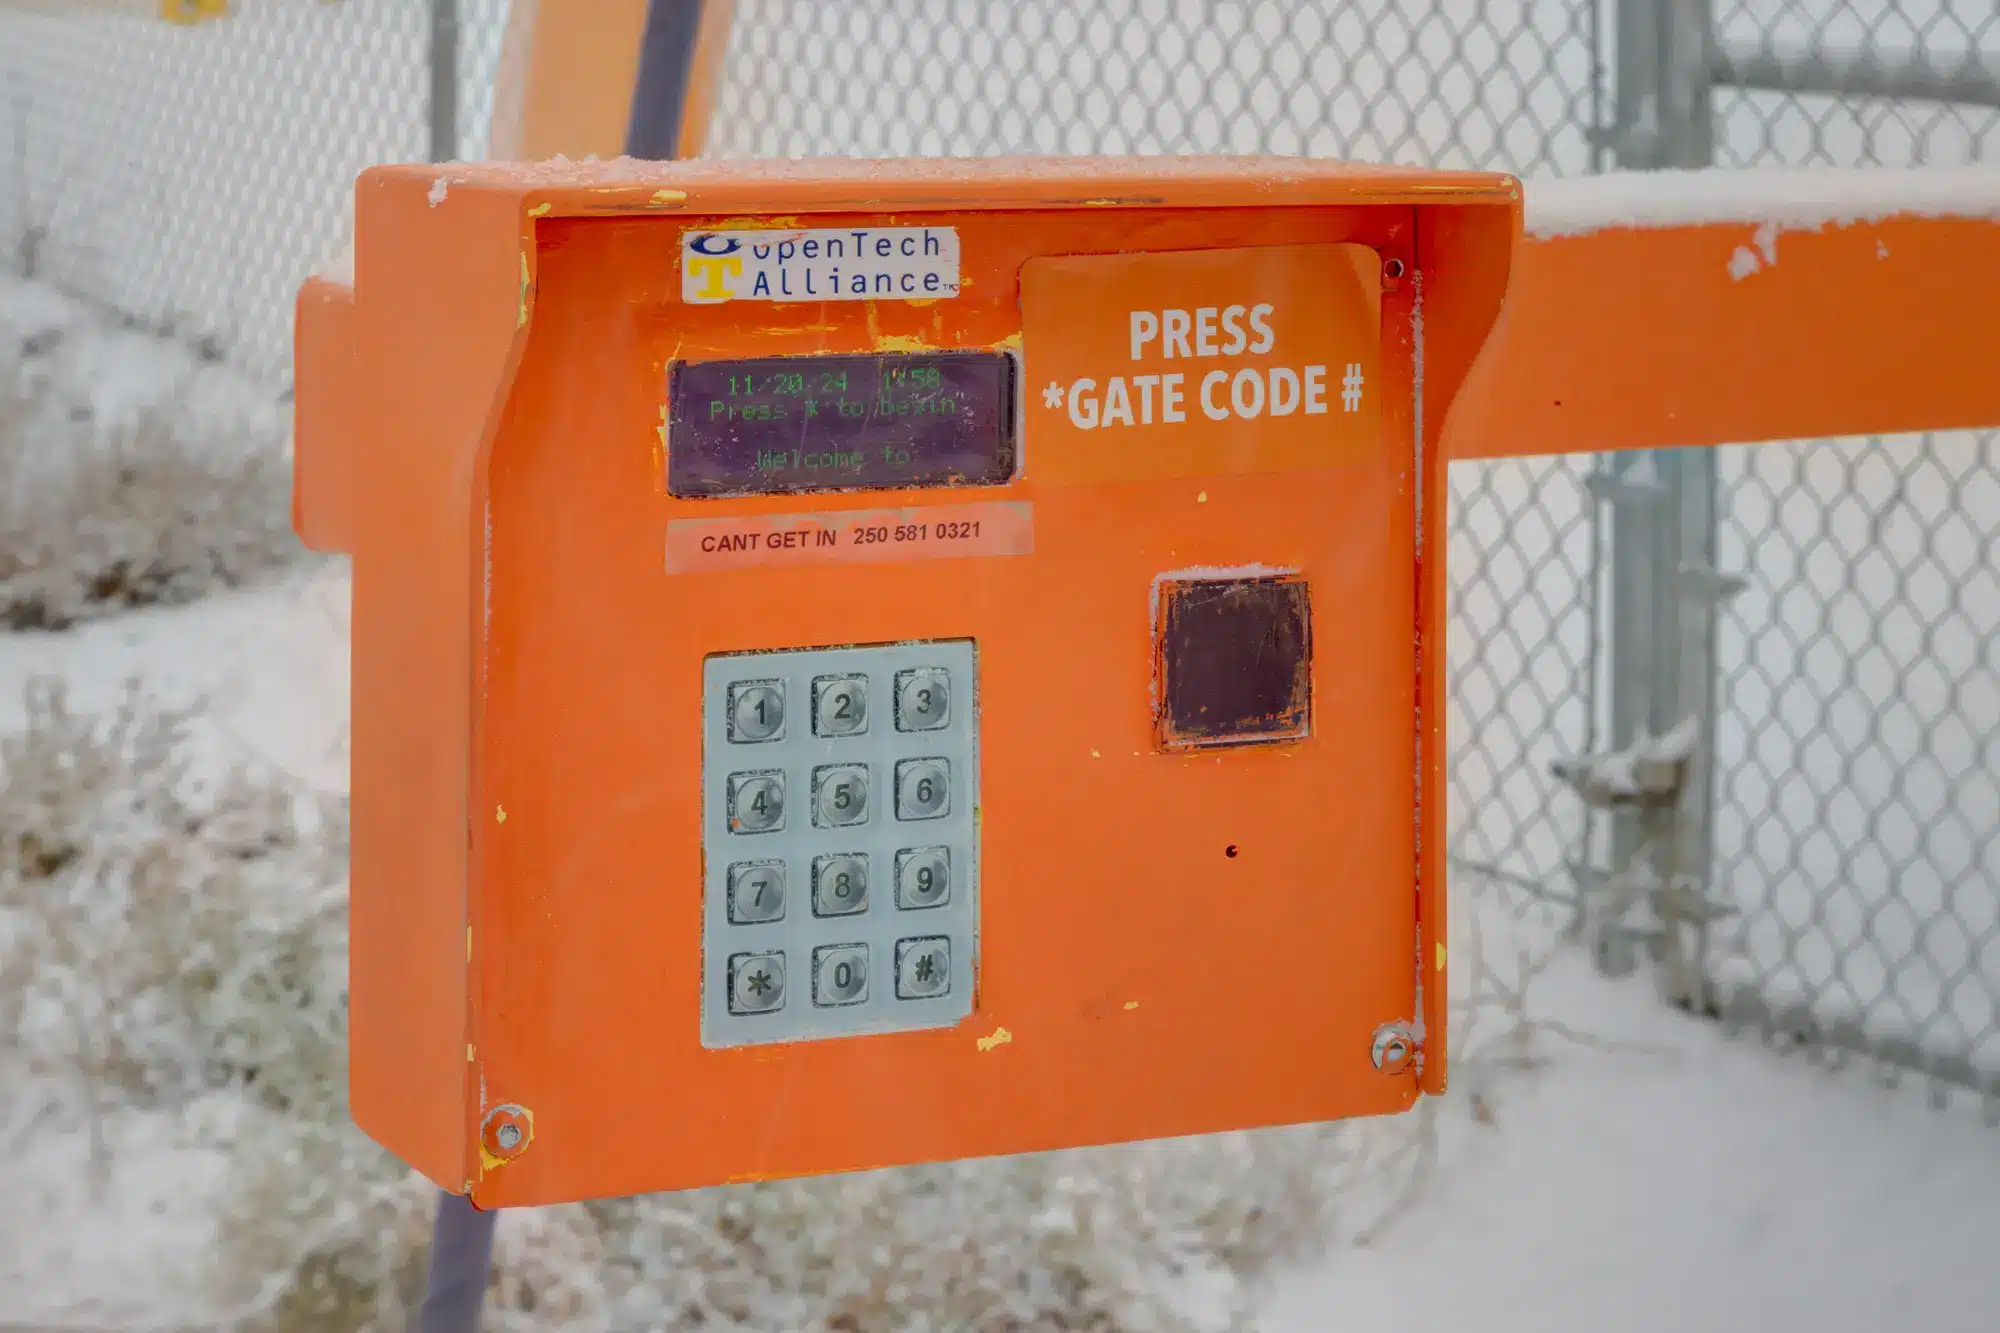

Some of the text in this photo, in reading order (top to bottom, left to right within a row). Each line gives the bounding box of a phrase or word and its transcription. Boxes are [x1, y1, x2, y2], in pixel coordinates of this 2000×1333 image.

[753, 267, 940, 296] Alliance
[1130, 303, 1275, 361] PRESS
[710, 399, 789, 422] Press
[837, 396, 865, 417] to
[1200, 365, 1328, 421] CODE
[1341, 363, 1365, 412] #
[757, 445, 910, 470] Welcome to
[701, 521, 981, 553] CANT GET IN 250 581 0321
[753, 688, 933, 726] 1 2 3
[751, 777, 933, 816] 4 5 6
[751, 866, 934, 907] 7 8 9
[834, 962, 851, 989] 0
[915, 953, 934, 983] #
